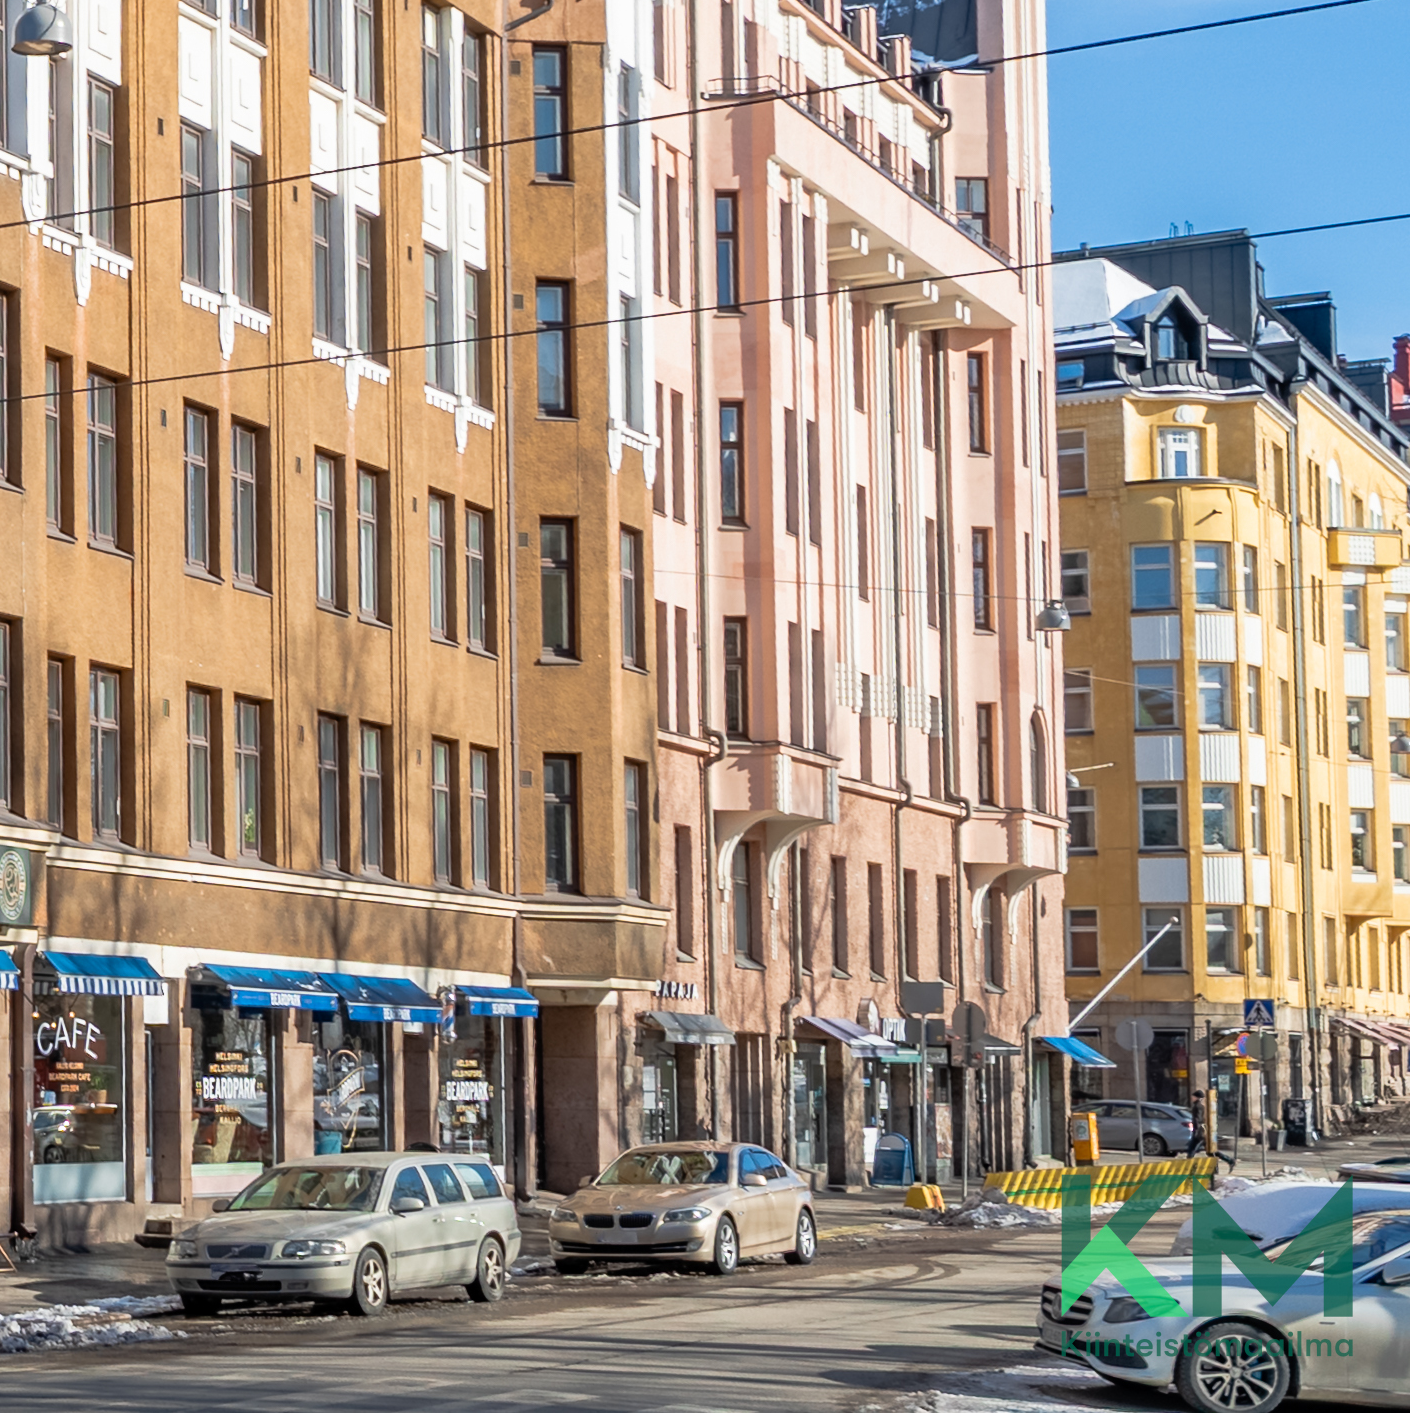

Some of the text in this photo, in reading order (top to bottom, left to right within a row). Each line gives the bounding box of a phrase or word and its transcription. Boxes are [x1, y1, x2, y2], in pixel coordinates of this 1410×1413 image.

[270, 992, 301, 1007] BEARDPARK
[655, 979, 699, 999] PAPAJA
[37, 1016, 101, 1060] CAFE
[202, 1076, 257, 1100] BEARDPARK
[446, 1080, 490, 1101] BEARDPARK
